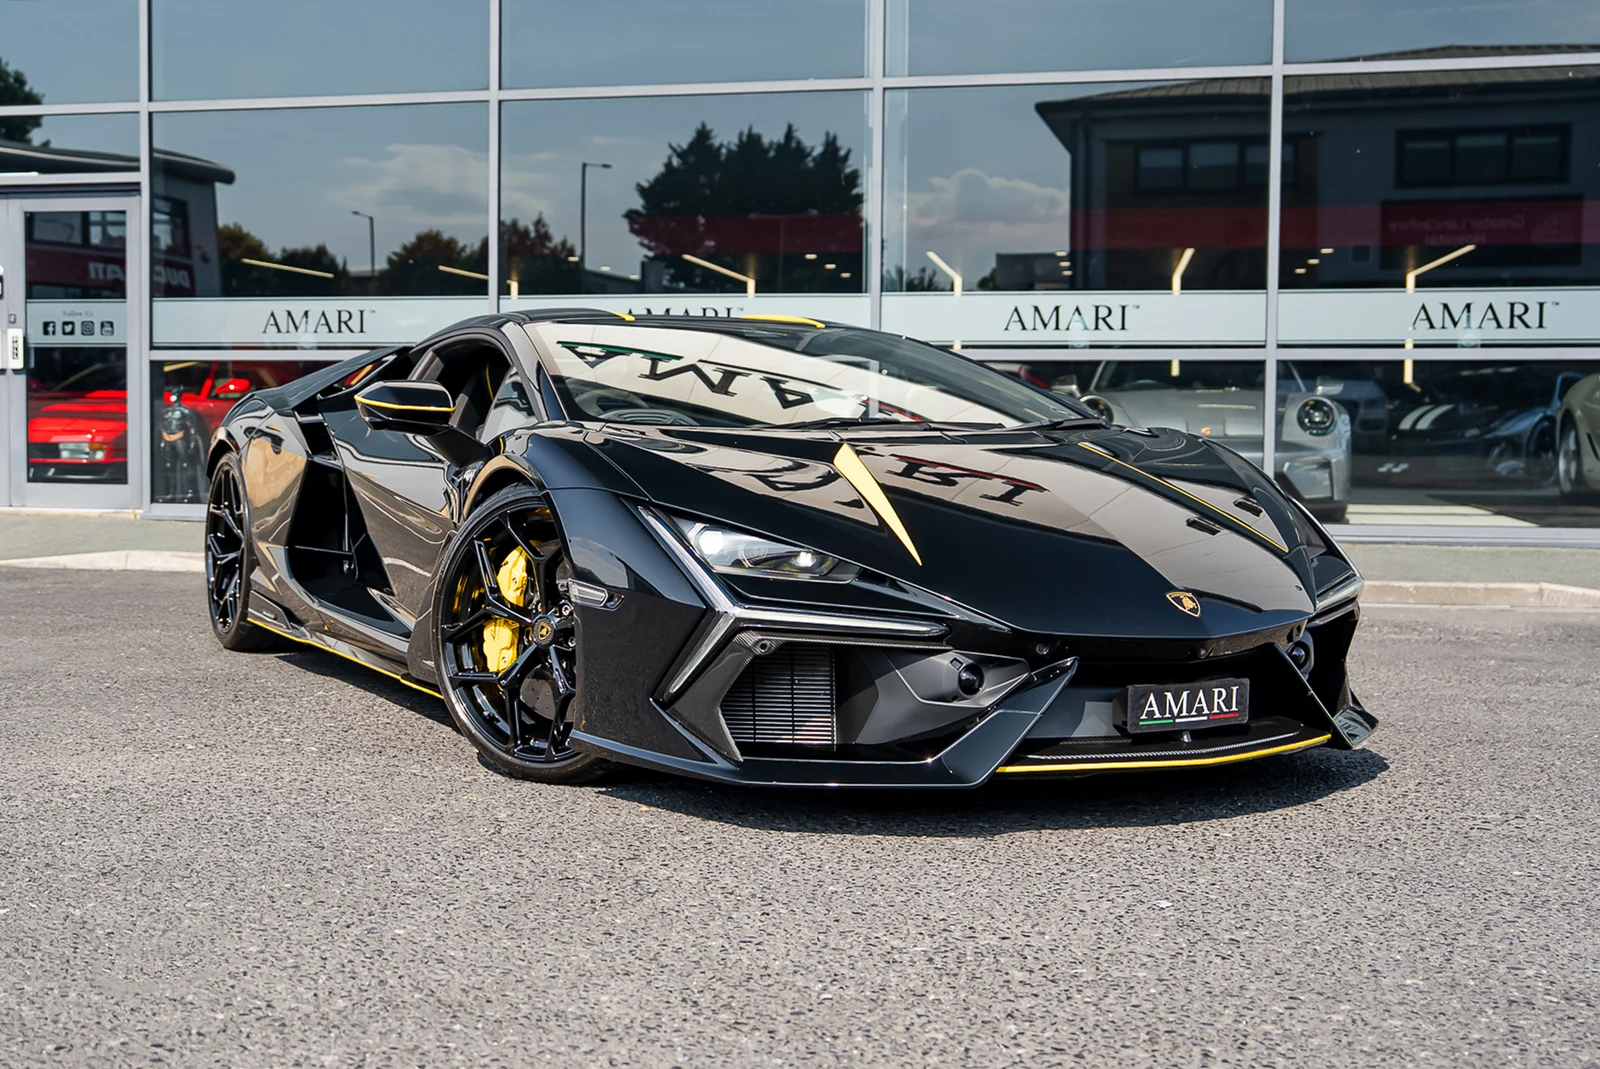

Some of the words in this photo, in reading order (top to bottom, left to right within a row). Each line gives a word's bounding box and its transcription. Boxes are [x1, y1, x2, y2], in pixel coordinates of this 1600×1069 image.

[261, 309, 367, 334] AMARI
[1003, 304, 1129, 331] AMARI
[1411, 301, 1548, 330] AMARI
[1140, 686, 1240, 719] AMARI
